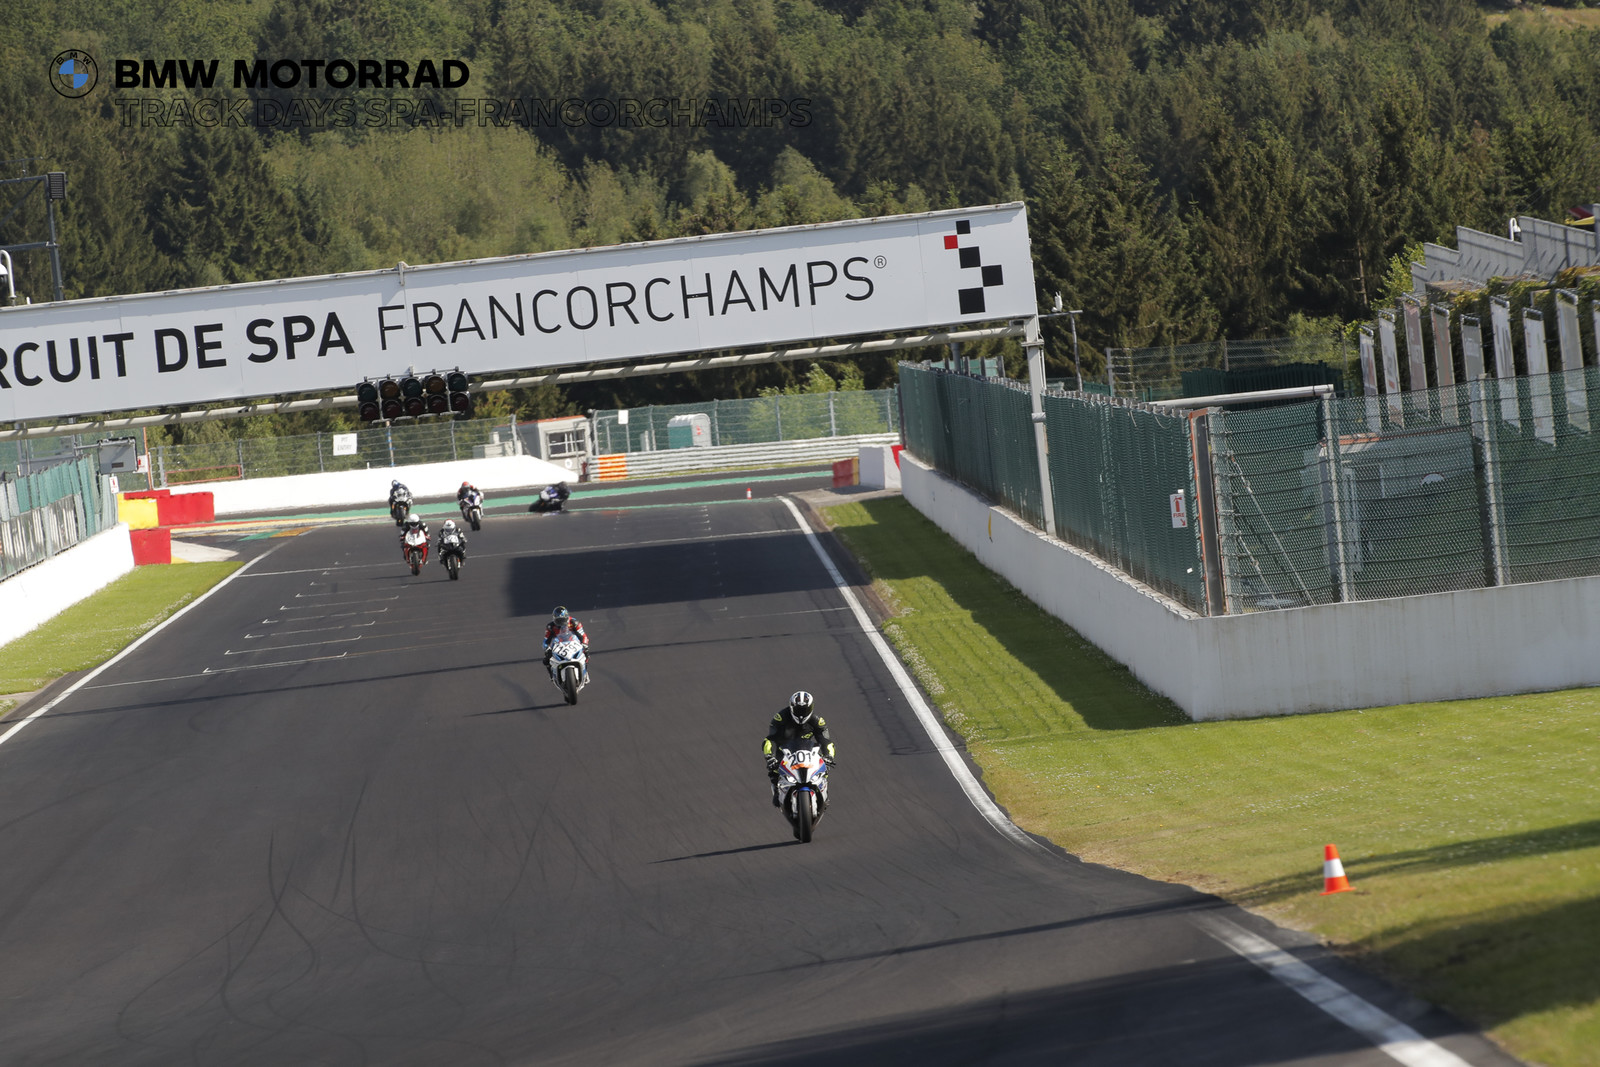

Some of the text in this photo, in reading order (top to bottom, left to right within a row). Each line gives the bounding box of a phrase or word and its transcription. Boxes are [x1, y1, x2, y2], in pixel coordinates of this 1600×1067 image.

[154, 323, 227, 373] DE
[246, 312, 355, 363] SPA
[788, 751, 811, 766] 201
